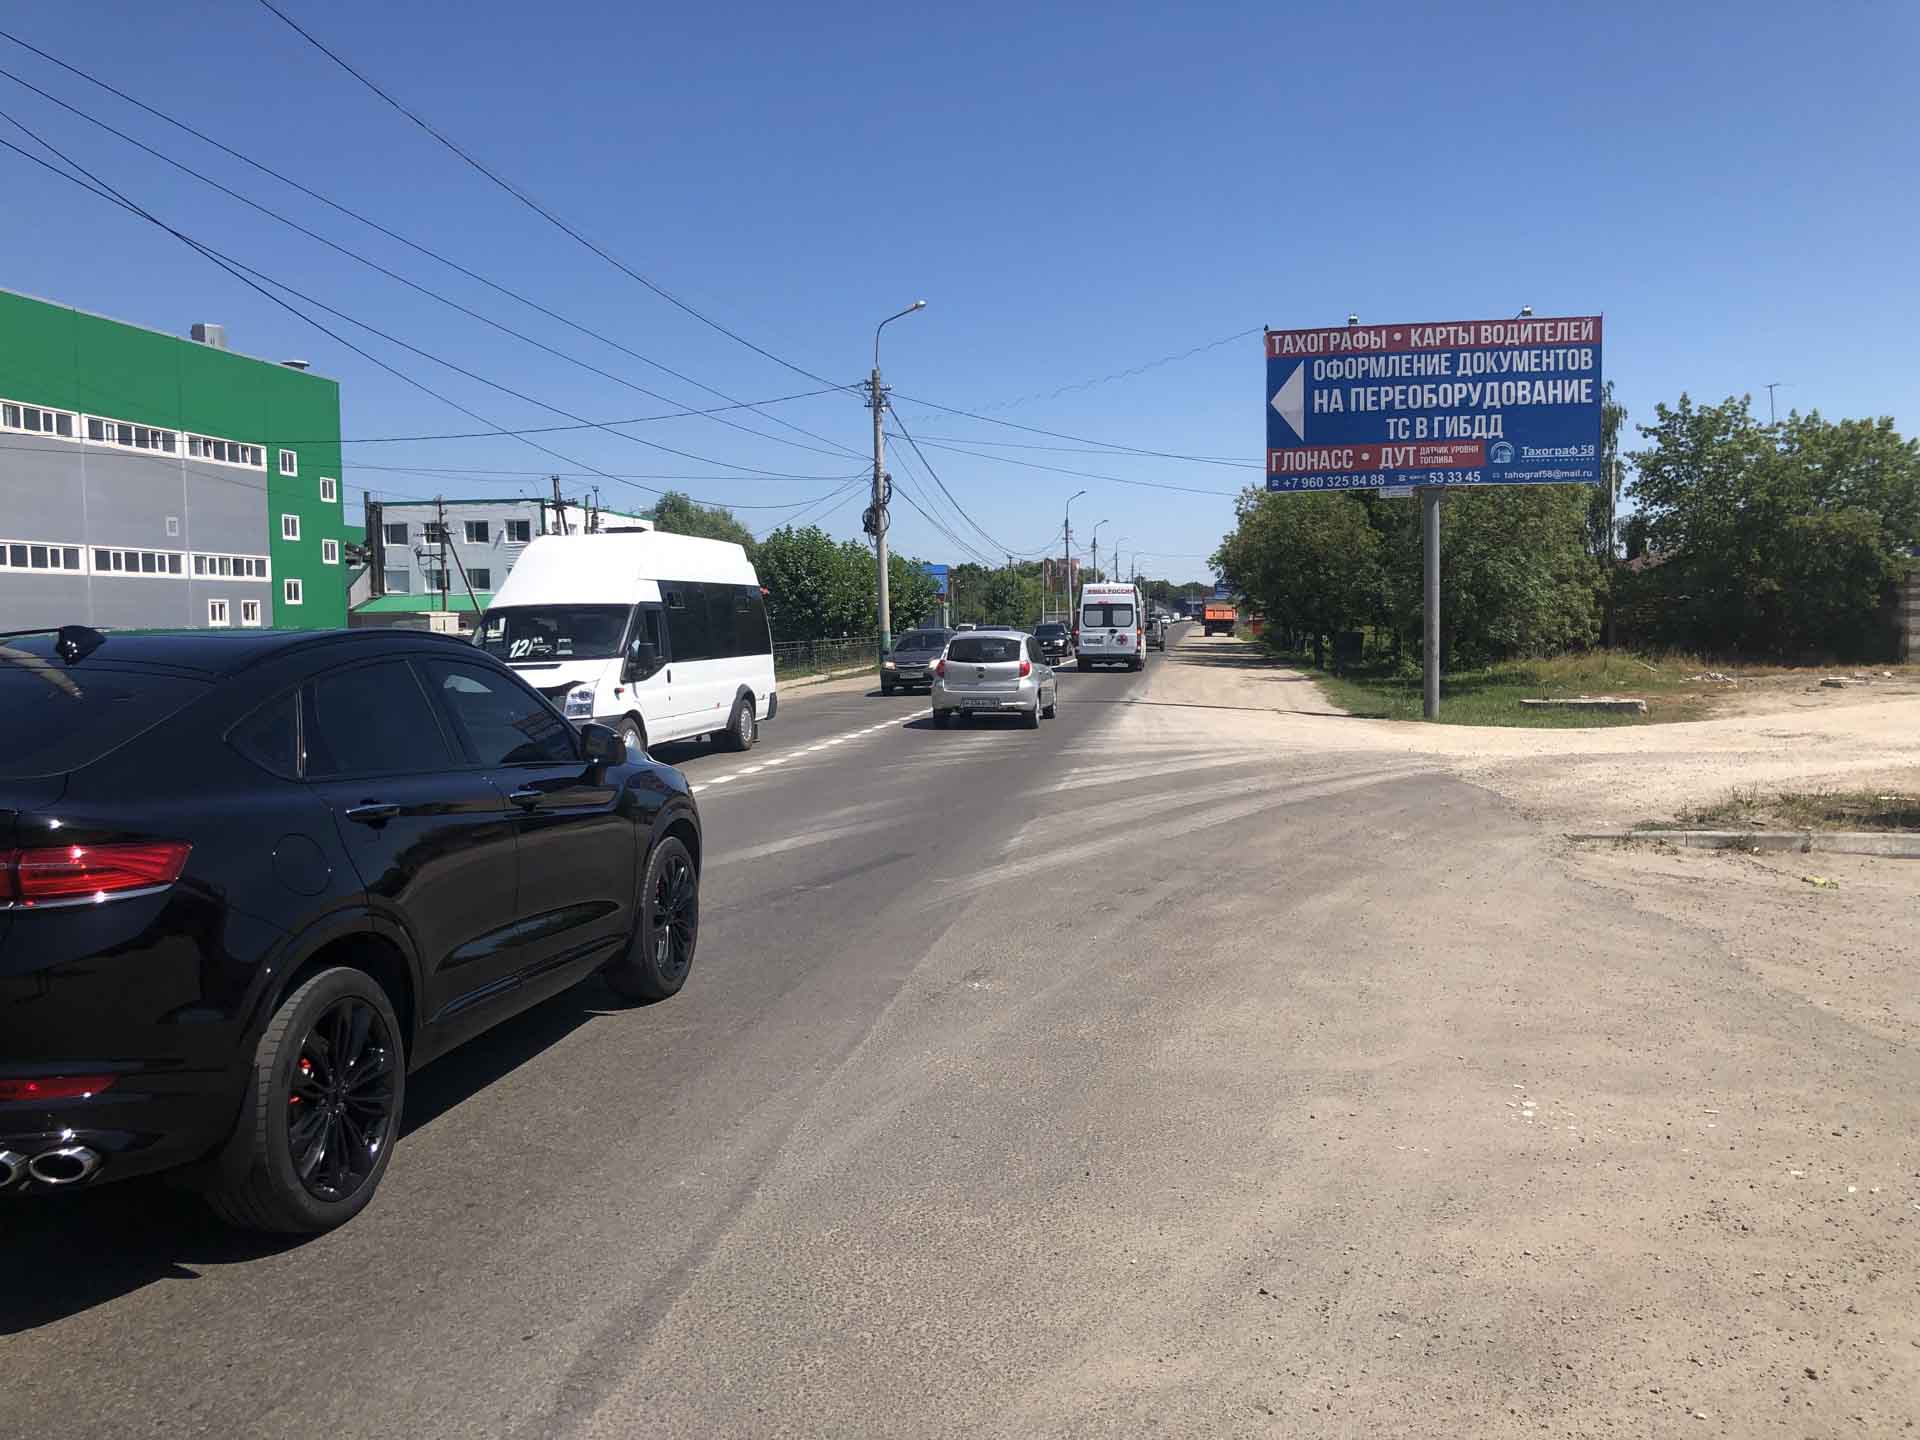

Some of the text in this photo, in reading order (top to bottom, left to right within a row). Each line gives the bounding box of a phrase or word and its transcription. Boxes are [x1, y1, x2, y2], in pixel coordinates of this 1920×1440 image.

[1271, 318, 1593, 354] ТАХОГРАФЫ КАРТЫ ВОДИТЕЛЕЙ
[1313, 349, 1593, 381] ОФОРМЛЕНИЕ ДОКУМЕНТОВ
[1313, 379, 1593, 414] НА ПЕРЕОБОРУДОВАНИЕ
[1386, 414, 1504, 440] ТС В ГИБДД
[1419, 446, 1449, 456] ДАТЧИК
[1521, 444, 1595, 456] Тахограф 58
[1271, 446, 1417, 472] ГЛОНАСС ДУТ
[1419, 455, 1453, 465] ТОПЛИВА
[1282, 473, 1385, 489] +7 960 325 84 88
[1429, 472, 1444, 483] 53
[1447, 471, 1462, 482] 33
[1465, 471, 1481, 482] 45
[1504, 470, 1593, 480] tahograf58@mail.ru
